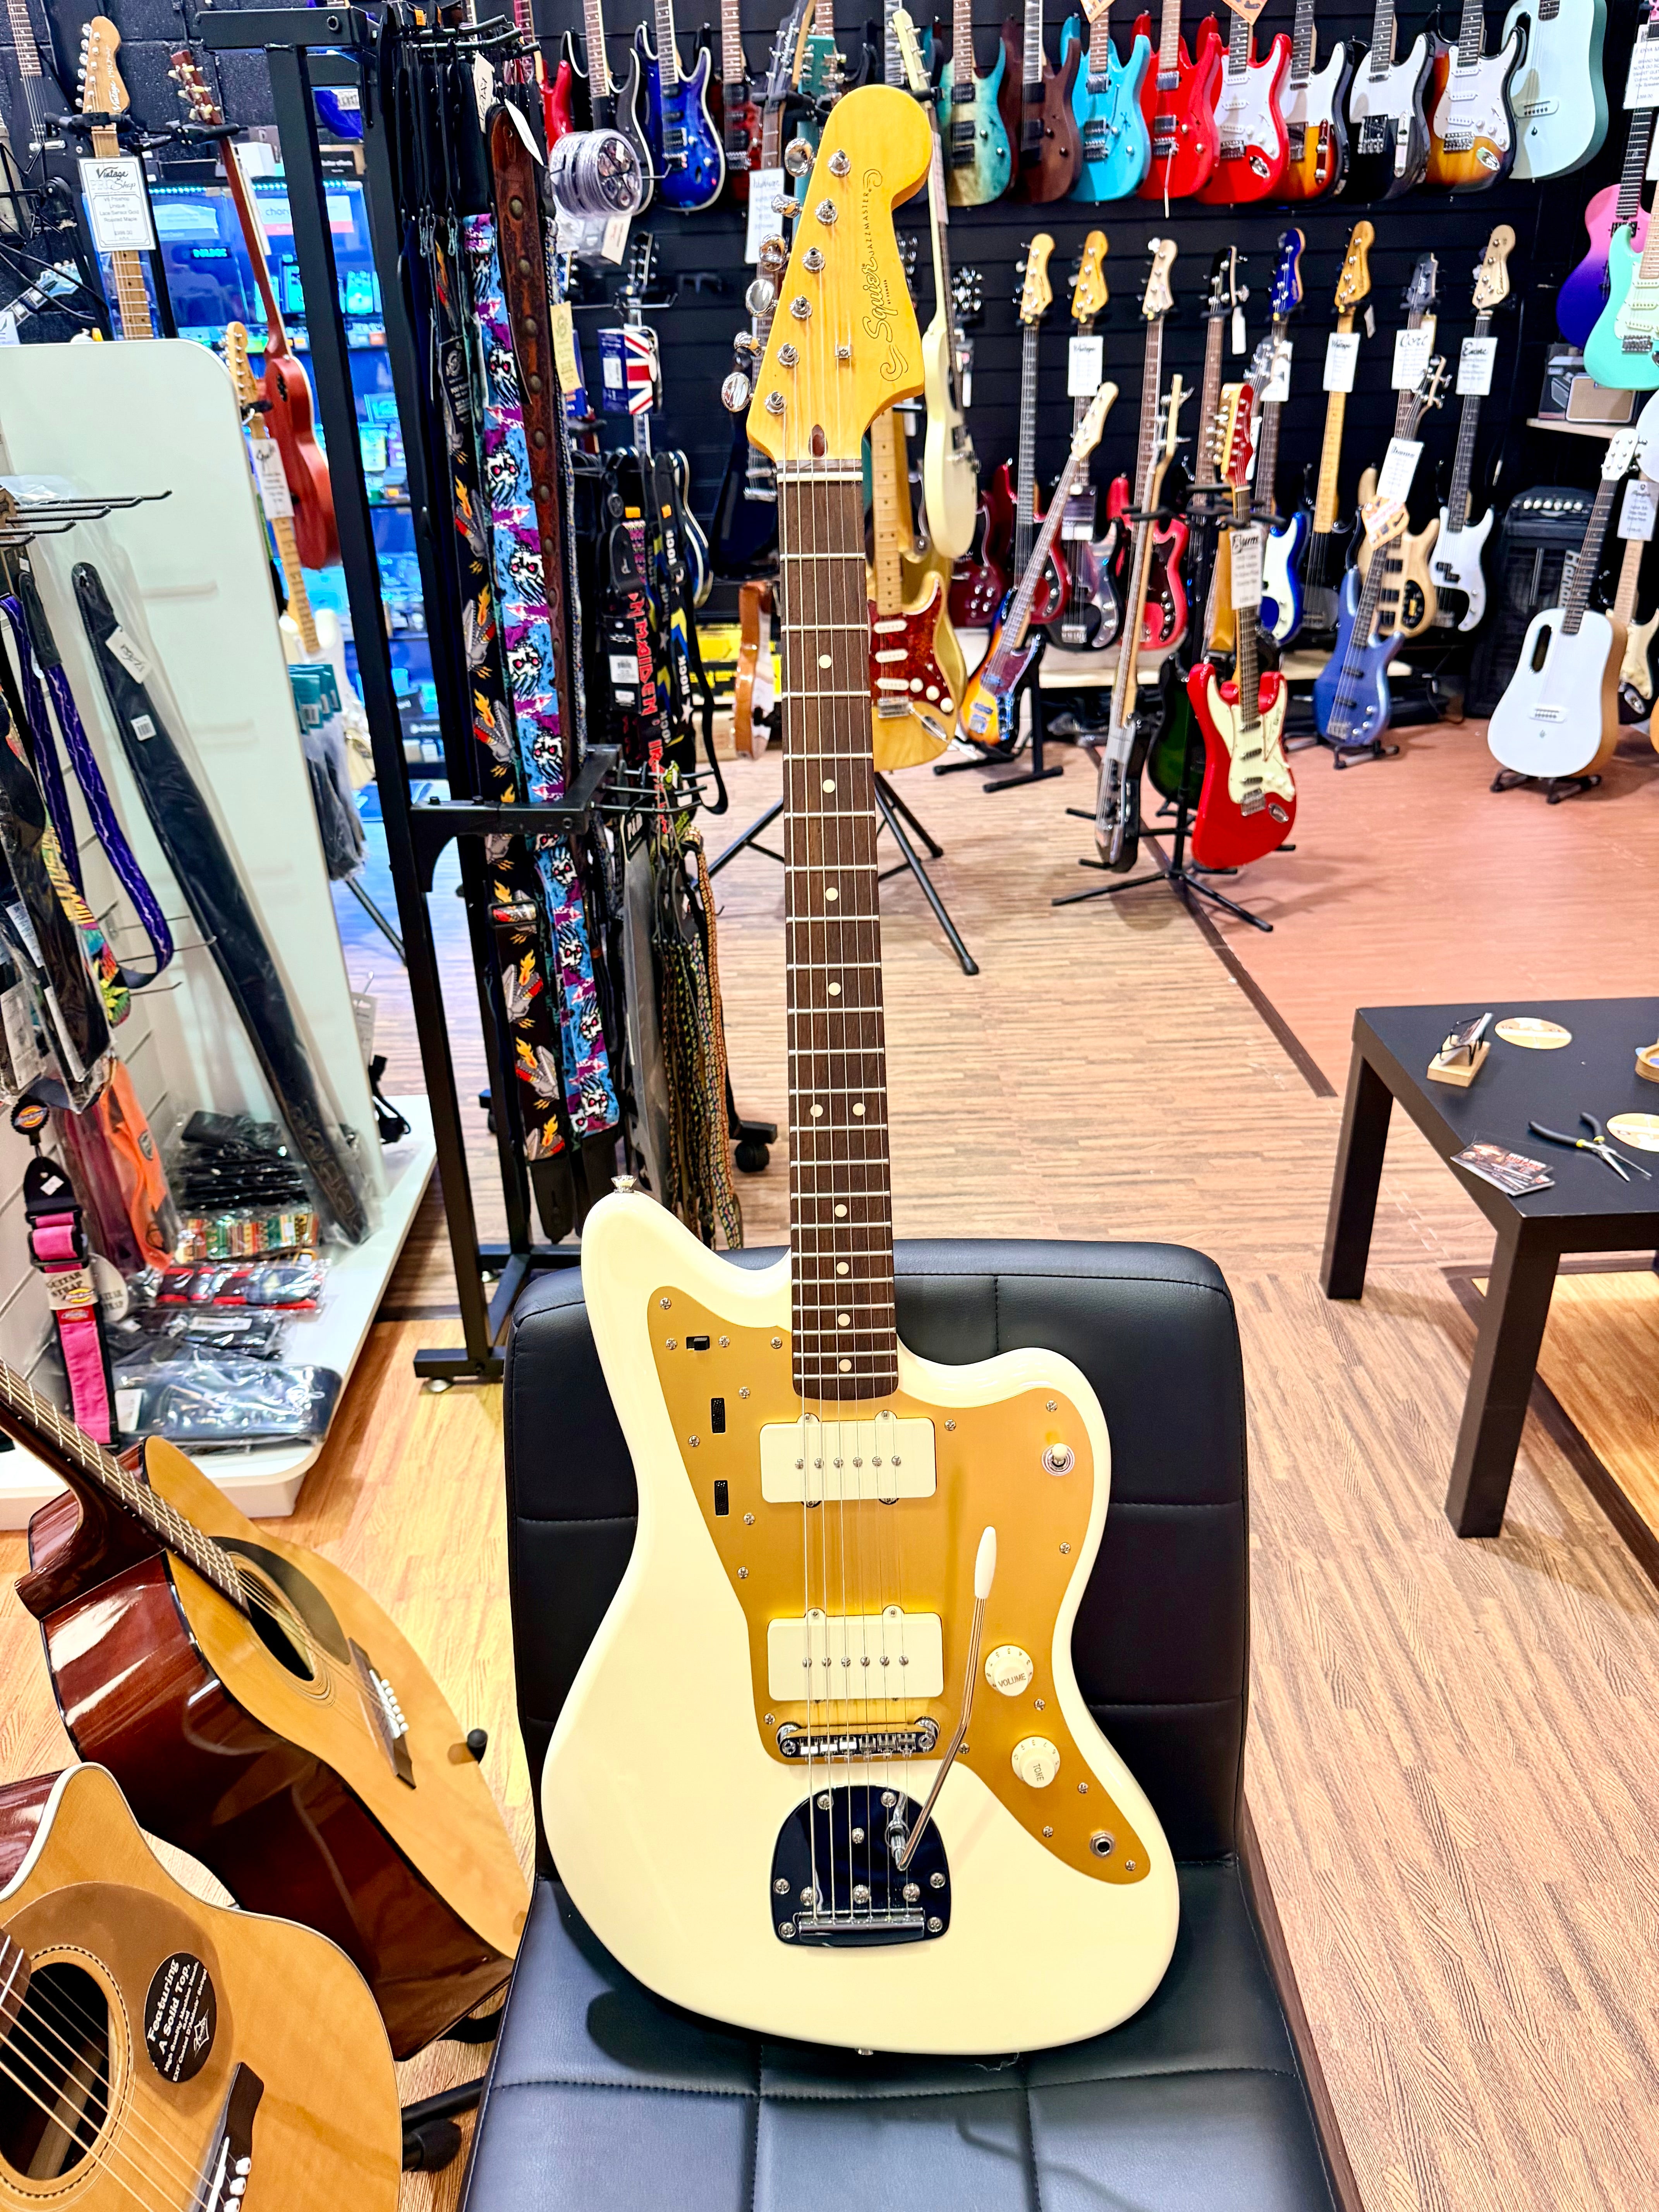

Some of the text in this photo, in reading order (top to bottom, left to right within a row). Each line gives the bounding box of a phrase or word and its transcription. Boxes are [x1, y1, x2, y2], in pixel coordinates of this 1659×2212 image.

[96, 167, 129, 180] Vintage
[110, 179, 136, 191] Shop
[862, 192, 874, 256] JAZZMASTER
[861, 257, 898, 342] Squier
[635, 618, 658, 716] MAIDEN
[46, 1271, 83, 1288] GUITAR
[51, 1280, 83, 1297] STRAP
[998, 1673, 1027, 1687] VOLUME
[1033, 1763, 1044, 1782] TONE
[147, 1959, 179, 2042] Featuring
[158, 1964, 191, 2055] A Solid Top,
[164, 2052, 173, 2072] High
[170, 2020, 183, 2052] Quality
[179, 1987, 191, 2020] Machine
[182, 2010, 190, 2030] and
[178, 2036, 189, 2064] Coated
